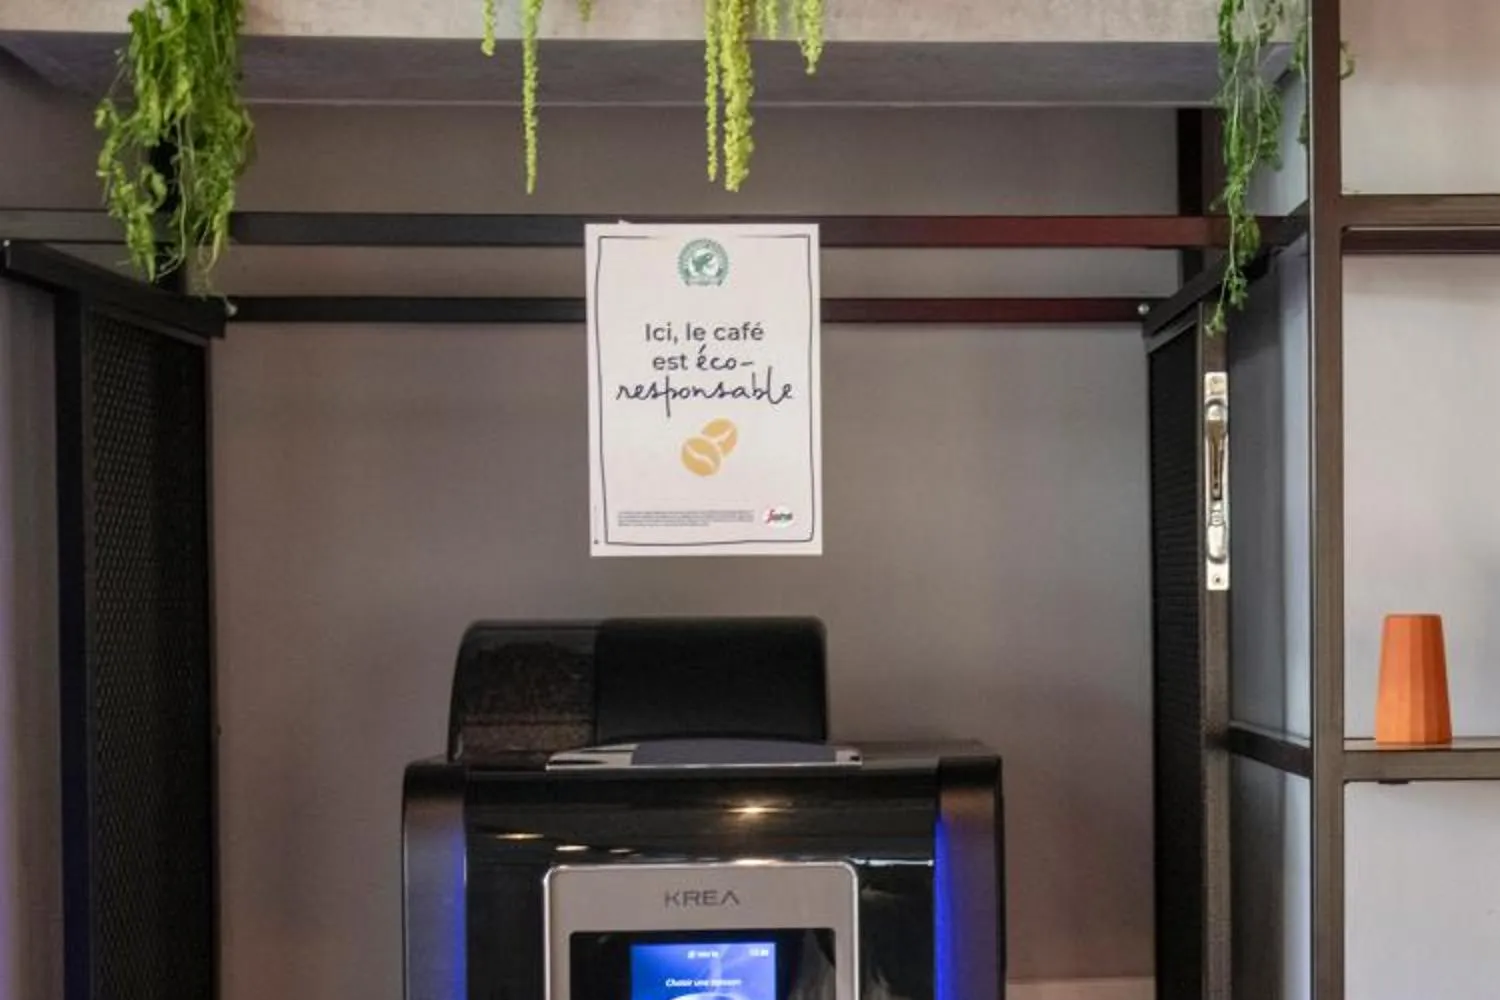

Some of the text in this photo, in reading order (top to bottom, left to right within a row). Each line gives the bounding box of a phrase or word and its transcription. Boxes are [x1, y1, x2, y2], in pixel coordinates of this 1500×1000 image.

[645, 321, 764, 344] Ici, le café
[652, 344, 755, 371] est éco-
[615, 365, 793, 418] responsable
[663, 889, 741, 908] KREA
